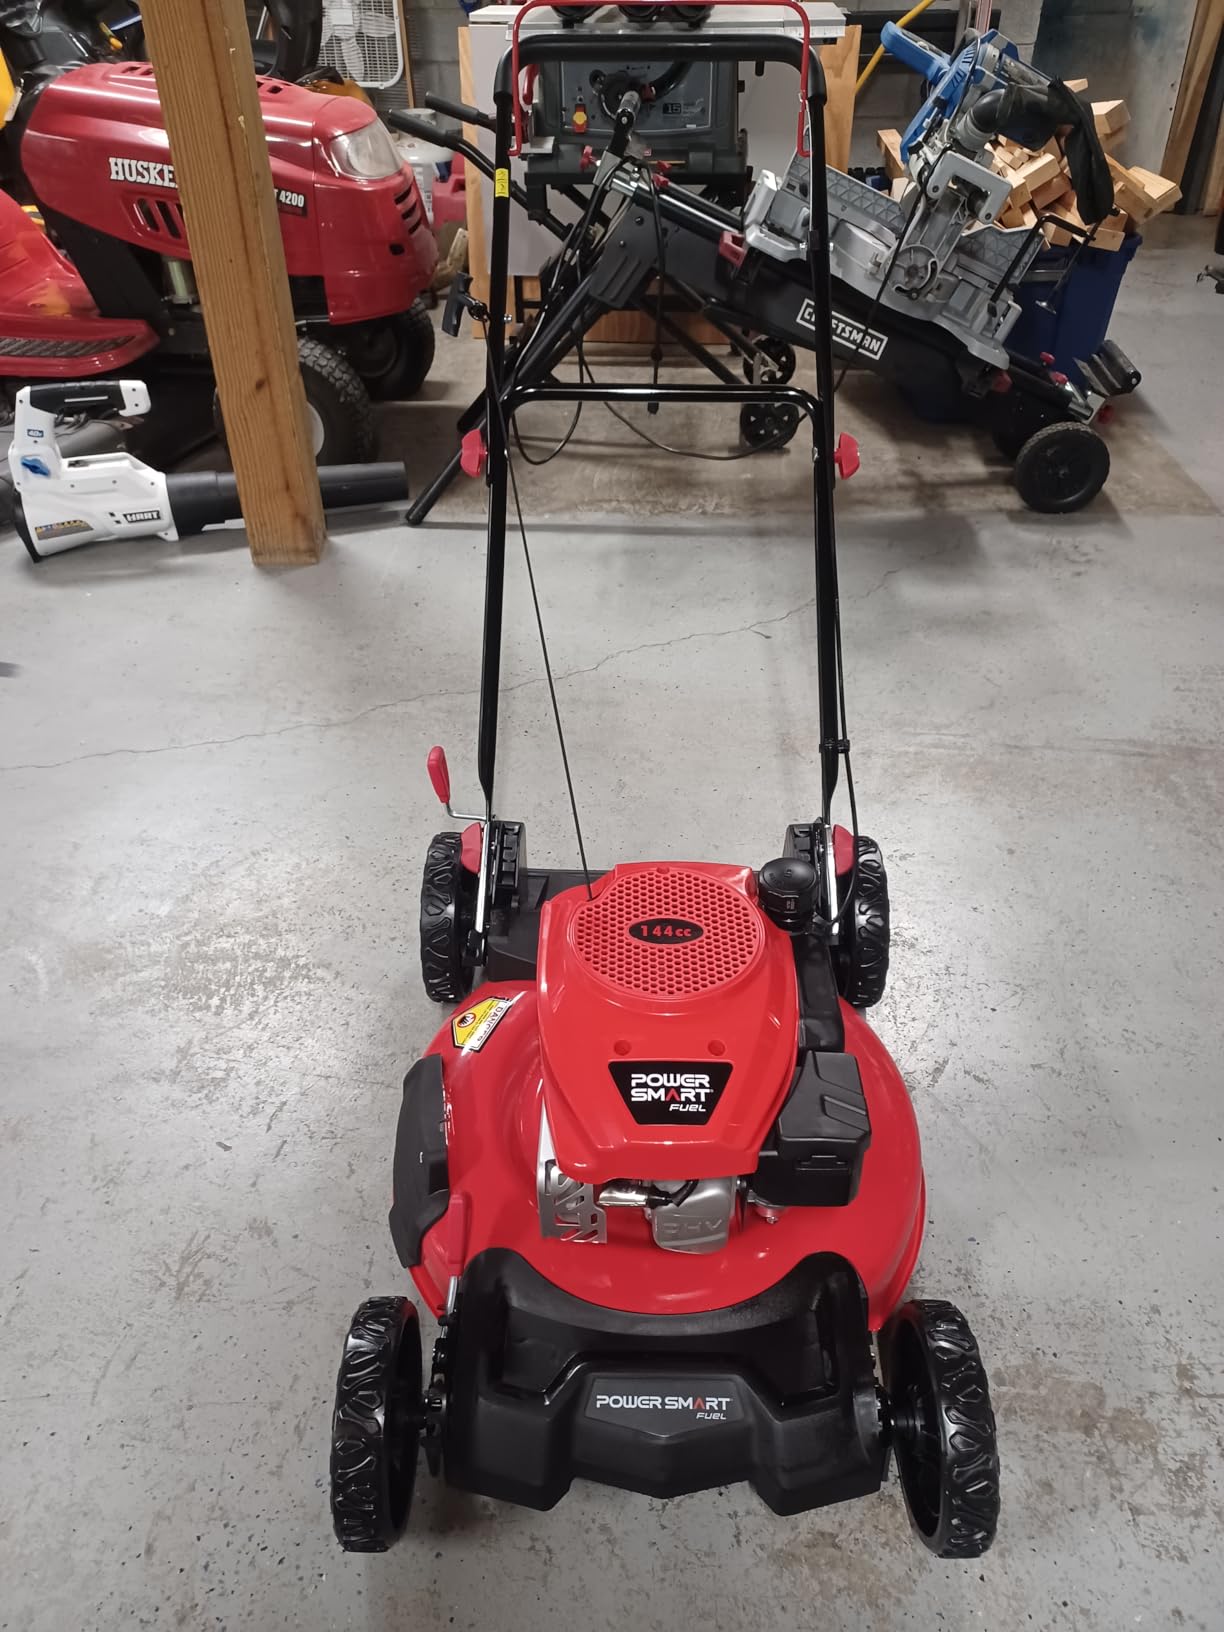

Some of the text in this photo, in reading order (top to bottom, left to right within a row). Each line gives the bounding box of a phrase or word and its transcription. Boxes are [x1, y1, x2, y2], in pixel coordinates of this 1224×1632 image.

[109, 157, 178, 188] HUSKE
[279, 190, 305, 208] 4200
[803, 307, 881, 352] CFTSMAN
[126, 511, 159, 522] HART
[641, 925, 692, 937] 144cc
[631, 1073, 710, 1088] POWER
[630, 1088, 711, 1102] SMART
[669, 1103, 707, 1112] FUEL
[696, 1412, 727, 1420] FUEL
